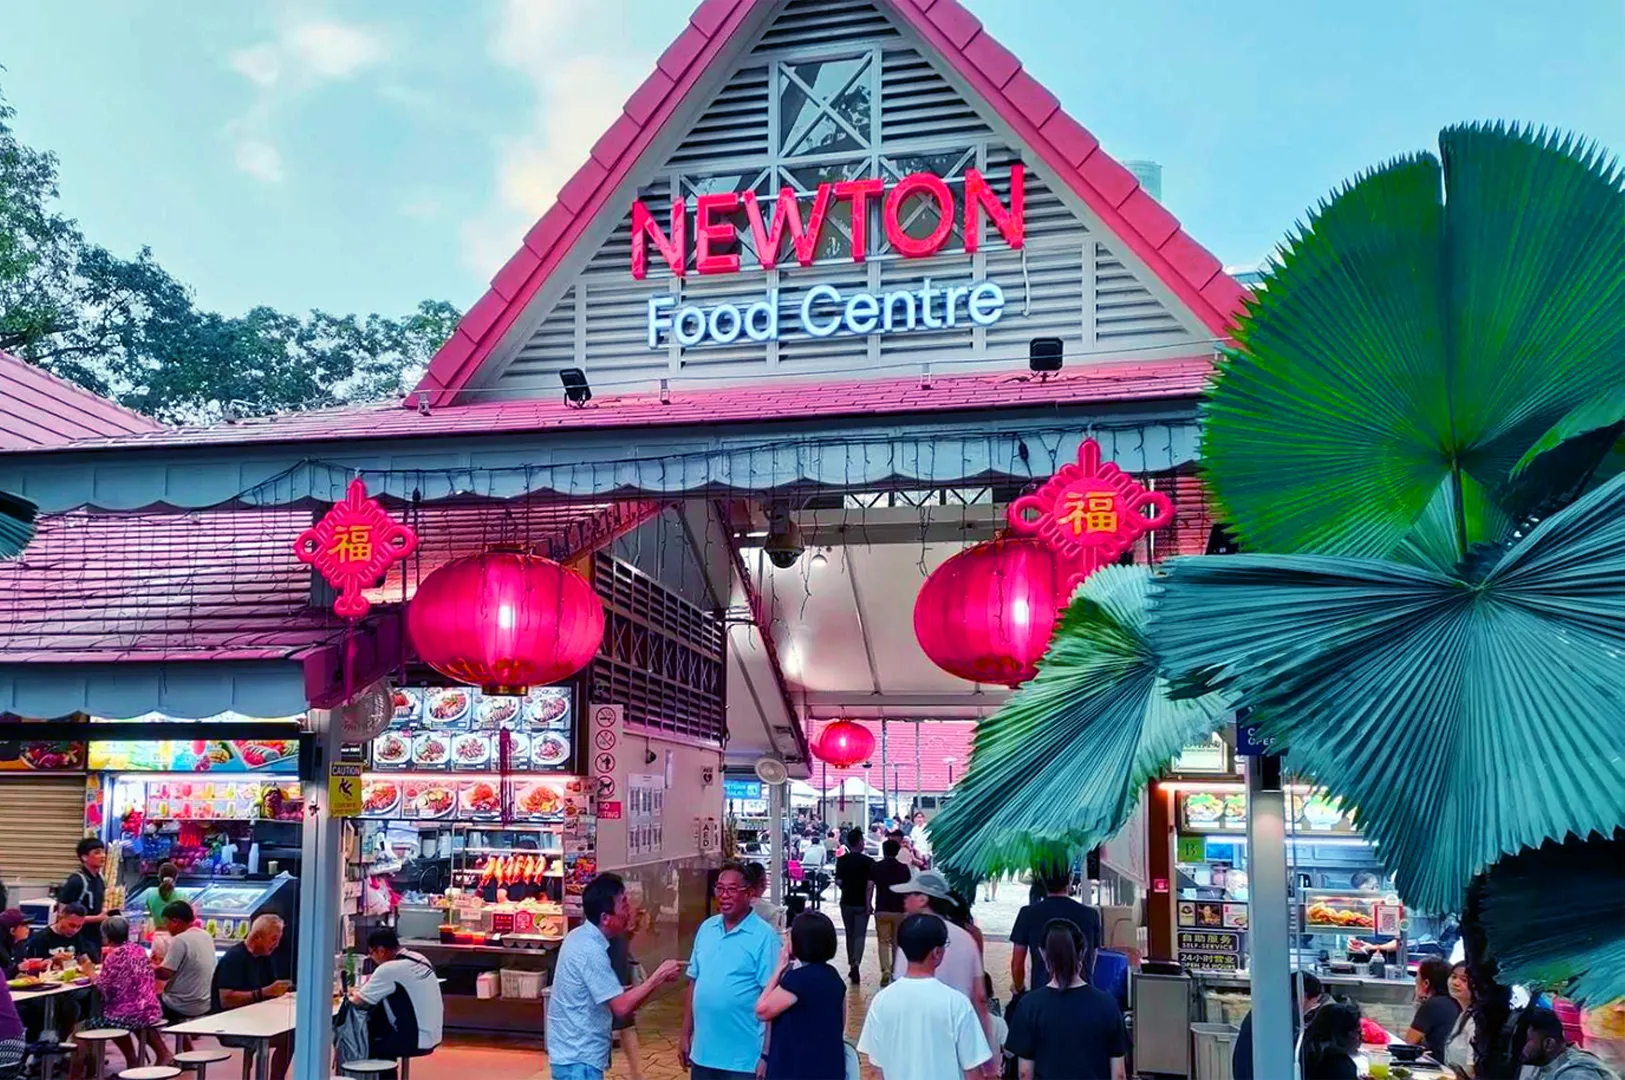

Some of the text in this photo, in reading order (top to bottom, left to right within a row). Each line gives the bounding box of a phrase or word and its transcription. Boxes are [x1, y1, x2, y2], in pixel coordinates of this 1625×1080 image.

[631, 164, 1025, 280] NEWTON
[646, 278, 1006, 348] Food Centre
[1056, 491, 1118, 535] 福
[327, 525, 373, 563] 福
[332, 766, 360, 776] CAUTION
[1182, 933, 1232, 944] 自助服务
